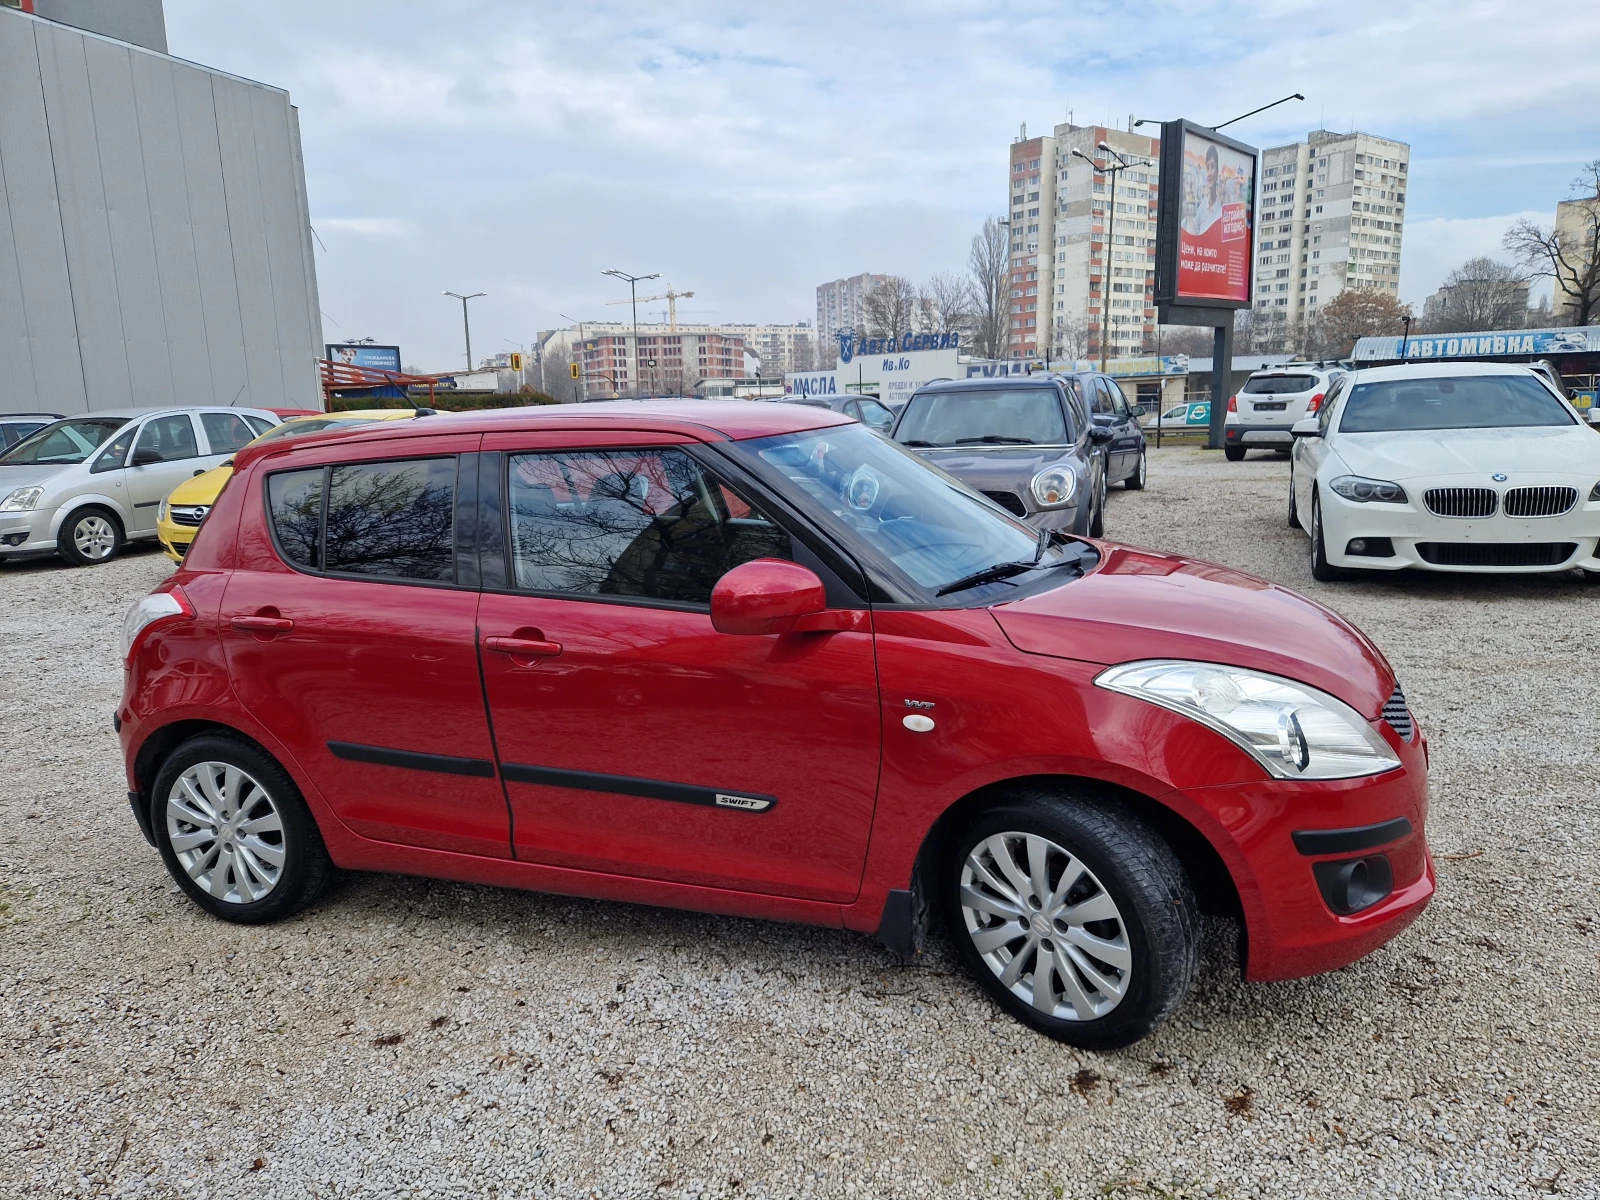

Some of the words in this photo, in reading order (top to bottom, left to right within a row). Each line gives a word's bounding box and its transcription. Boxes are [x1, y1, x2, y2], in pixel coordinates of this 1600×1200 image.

[1181, 241, 1195, 256] Цени,
[1196, 246, 1203, 256] на
[1180, 259, 1194, 270] може
[1194, 261, 1201, 272] да
[1408, 335, 1534, 357] АВТОМИВКА
[793, 376, 836, 395] МАСЛА
[904, 699, 935, 710] VVT
[720, 797, 757, 808] SWIFT
